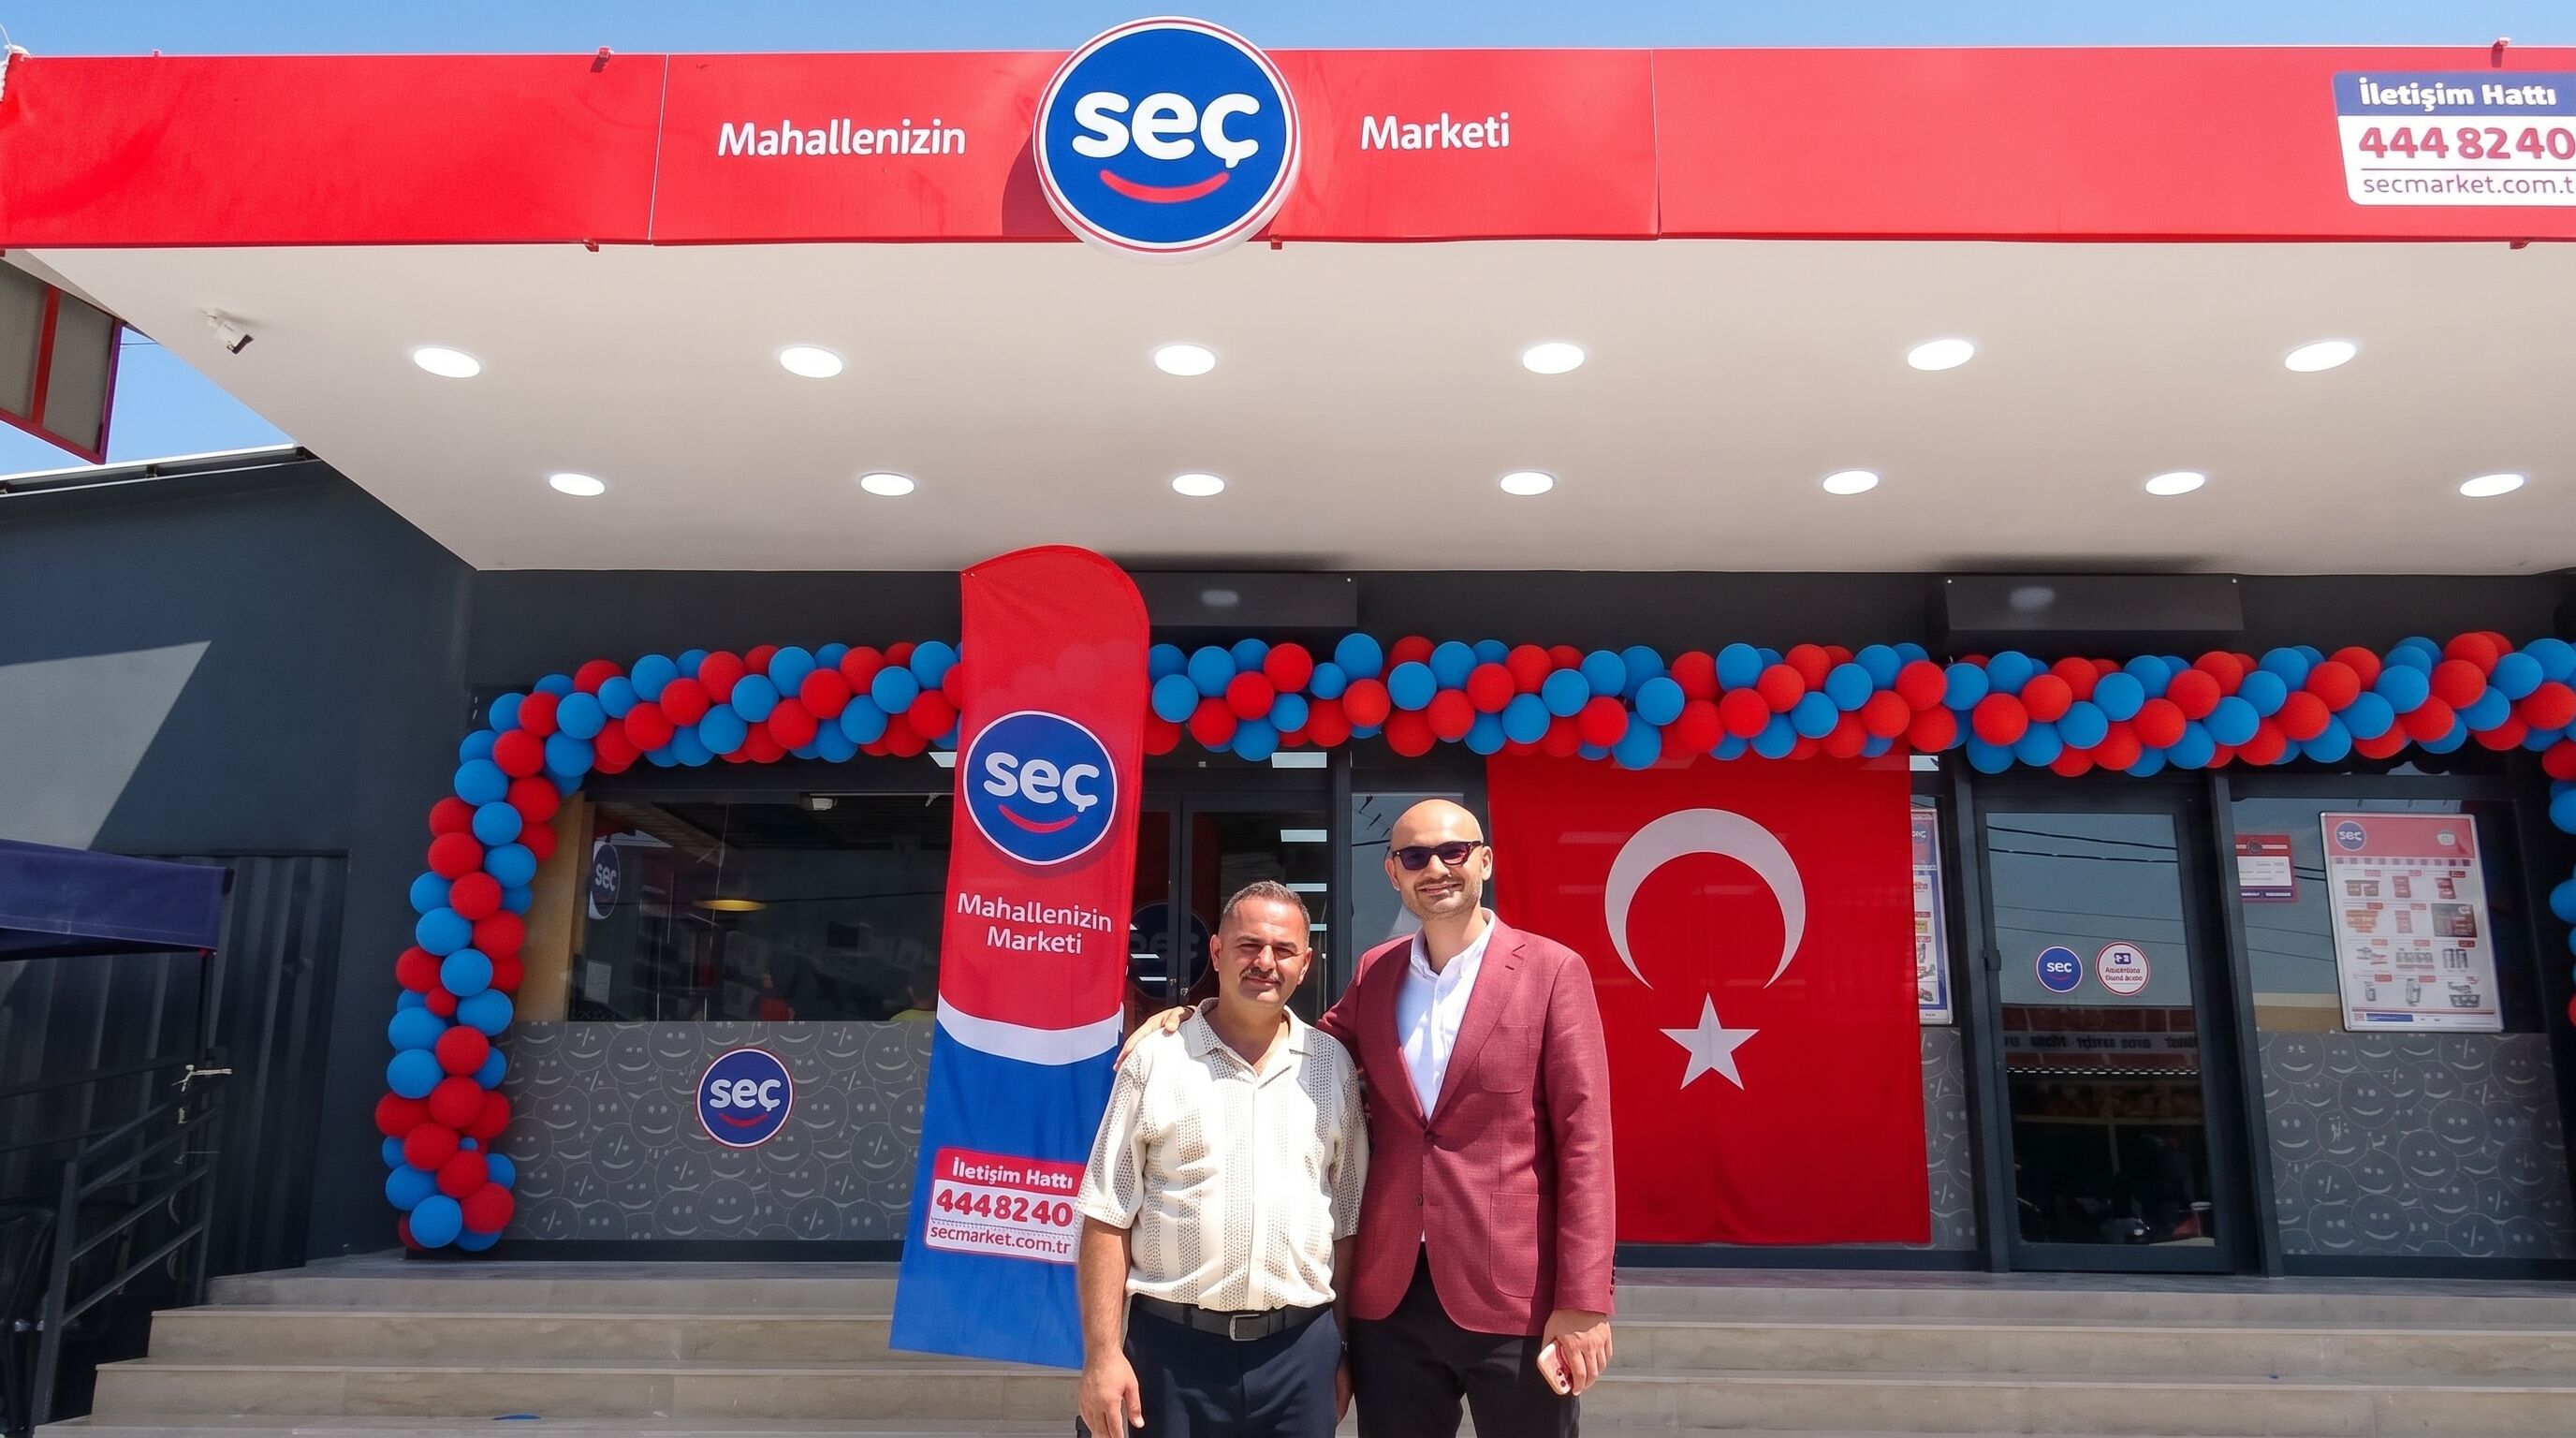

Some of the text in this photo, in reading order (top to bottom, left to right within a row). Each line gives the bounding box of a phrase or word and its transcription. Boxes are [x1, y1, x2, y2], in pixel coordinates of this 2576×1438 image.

[2359, 77, 2556, 111] İletişim Hattı
[717, 119, 966, 158] Mahallenizin
[1073, 92, 1260, 169] seç
[1360, 112, 1510, 151] Marketi
[2359, 127, 2449, 158] 444
[984, 752, 1099, 812] seç
[957, 892, 1112, 932] Mahallenizin
[987, 925, 1082, 954] Marketi
[709, 1078, 782, 1111] seç
[952, 1157, 1073, 1189] İletişim Hattı
[930, 1225, 1071, 1255] secmarket.com.tr
